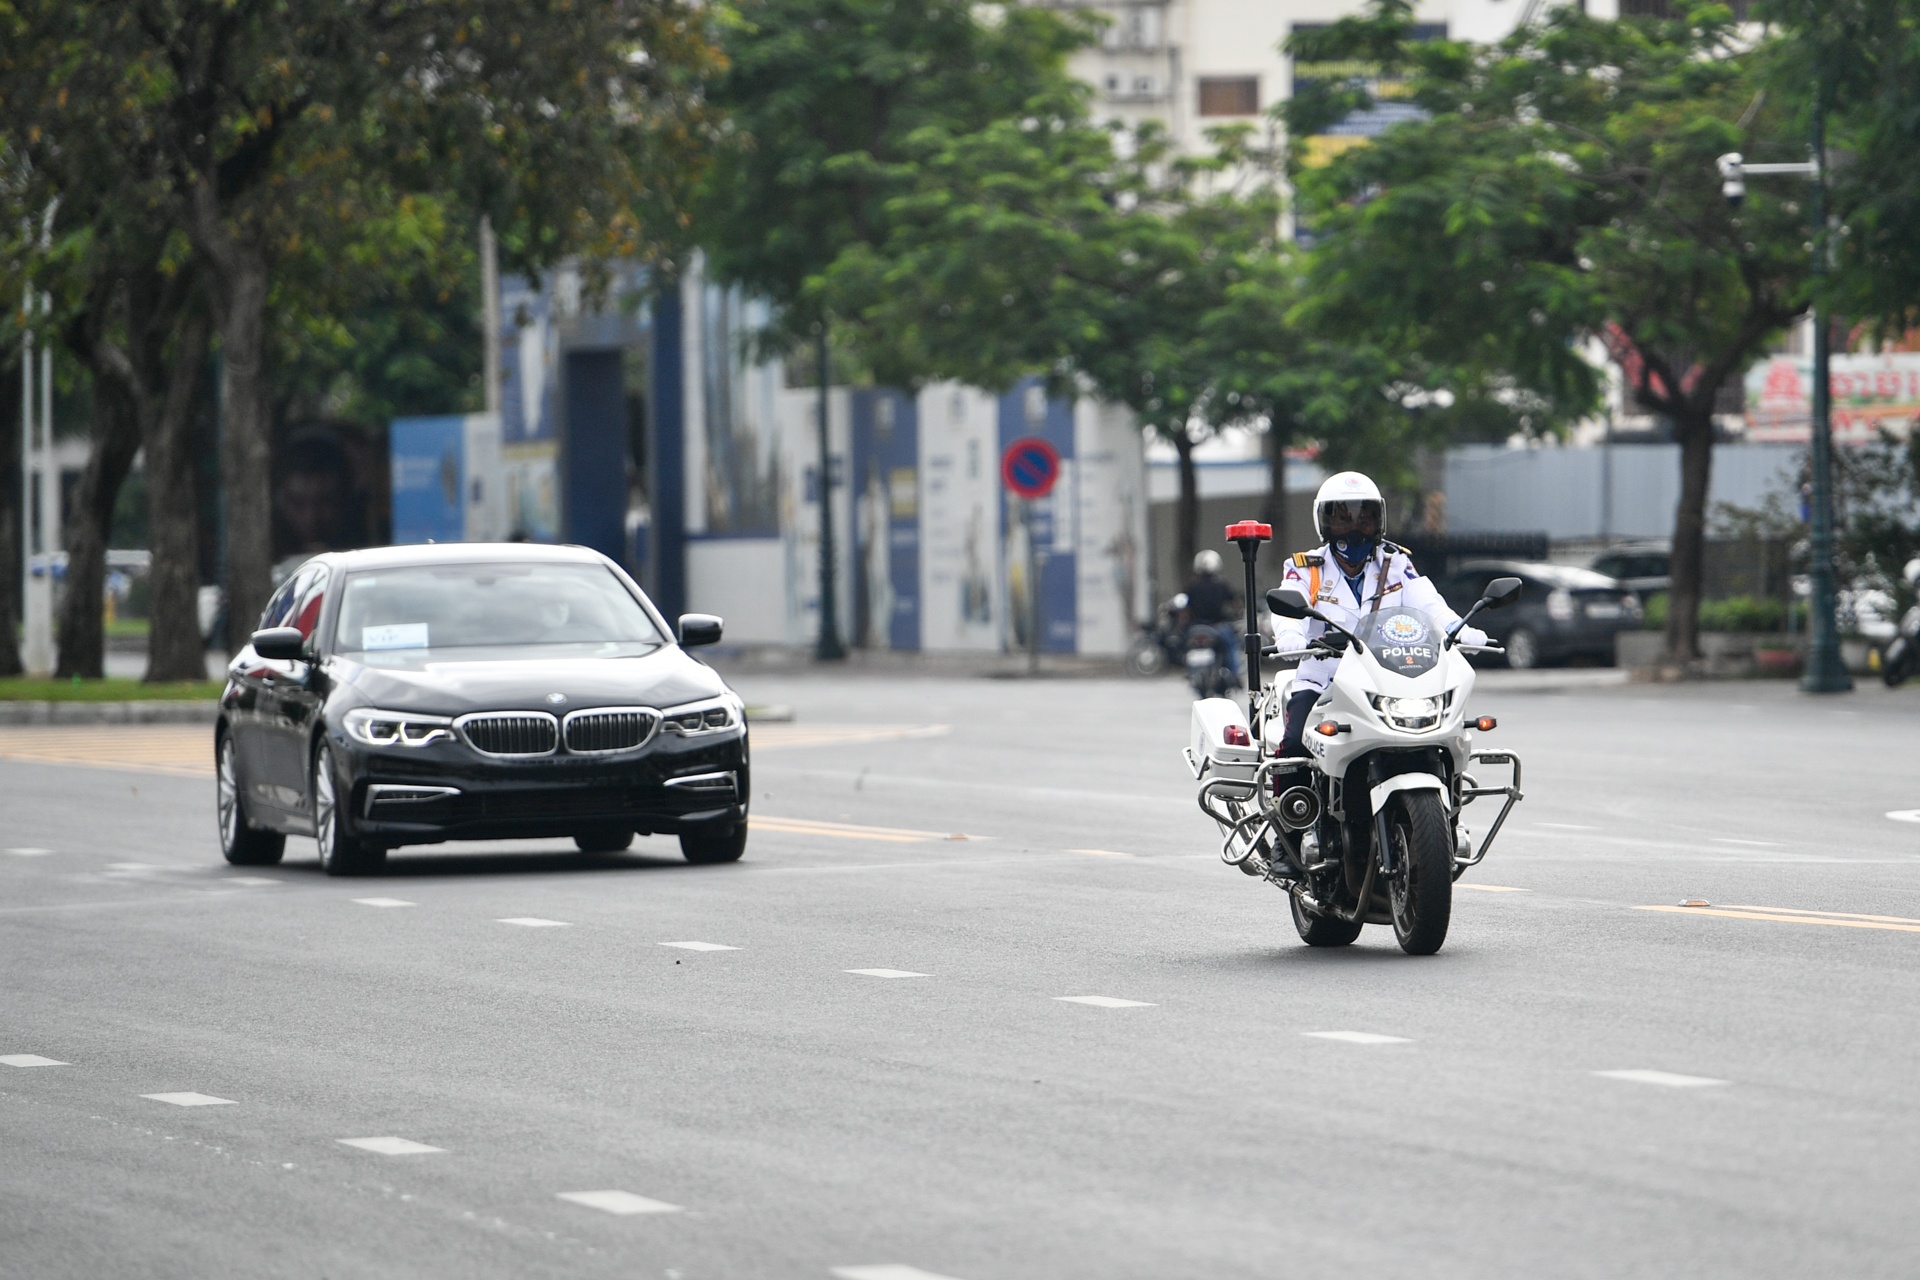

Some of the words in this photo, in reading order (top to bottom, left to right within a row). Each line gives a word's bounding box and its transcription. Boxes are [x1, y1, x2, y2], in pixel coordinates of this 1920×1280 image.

[1382, 646, 1432, 659] POLICE
[1405, 656, 1415, 665] 2
[1304, 733, 1326, 758] POLICE
